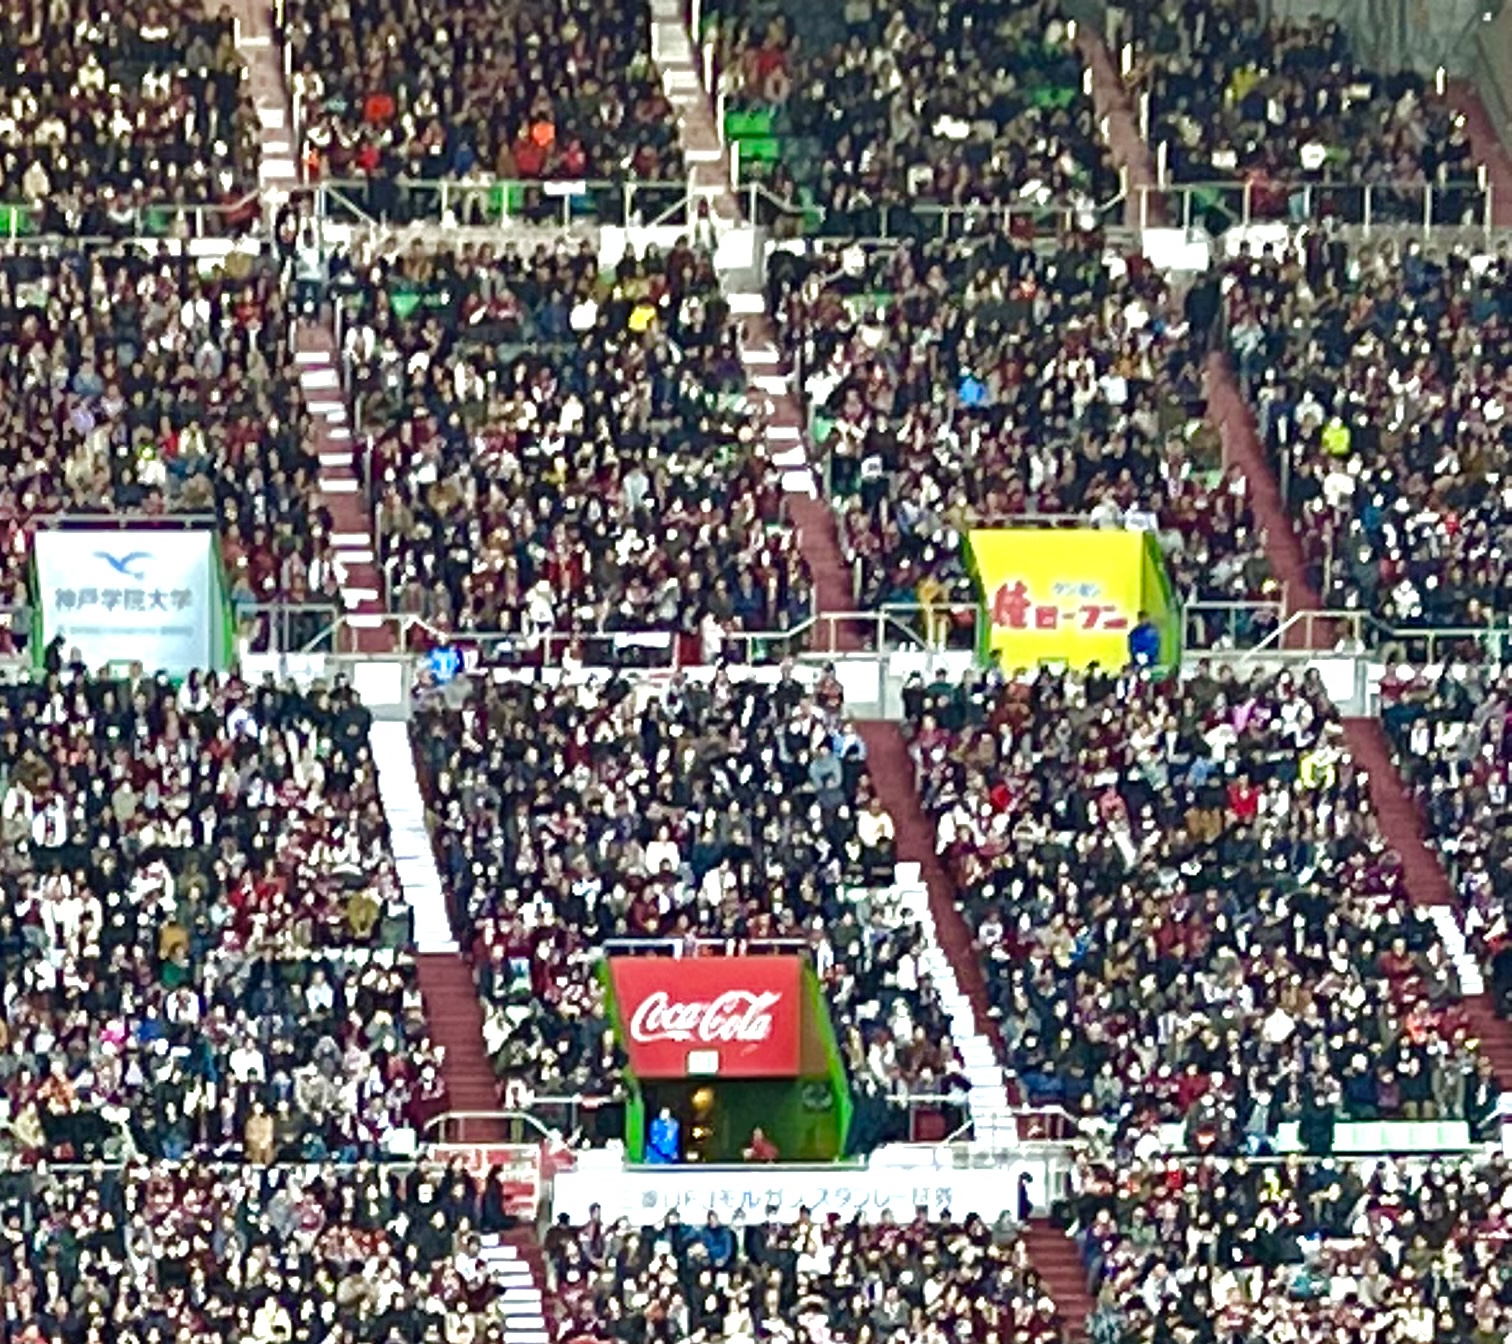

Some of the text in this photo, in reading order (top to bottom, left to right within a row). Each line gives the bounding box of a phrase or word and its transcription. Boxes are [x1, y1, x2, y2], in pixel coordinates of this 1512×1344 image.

[54, 588, 193, 612] 神戸学院大学
